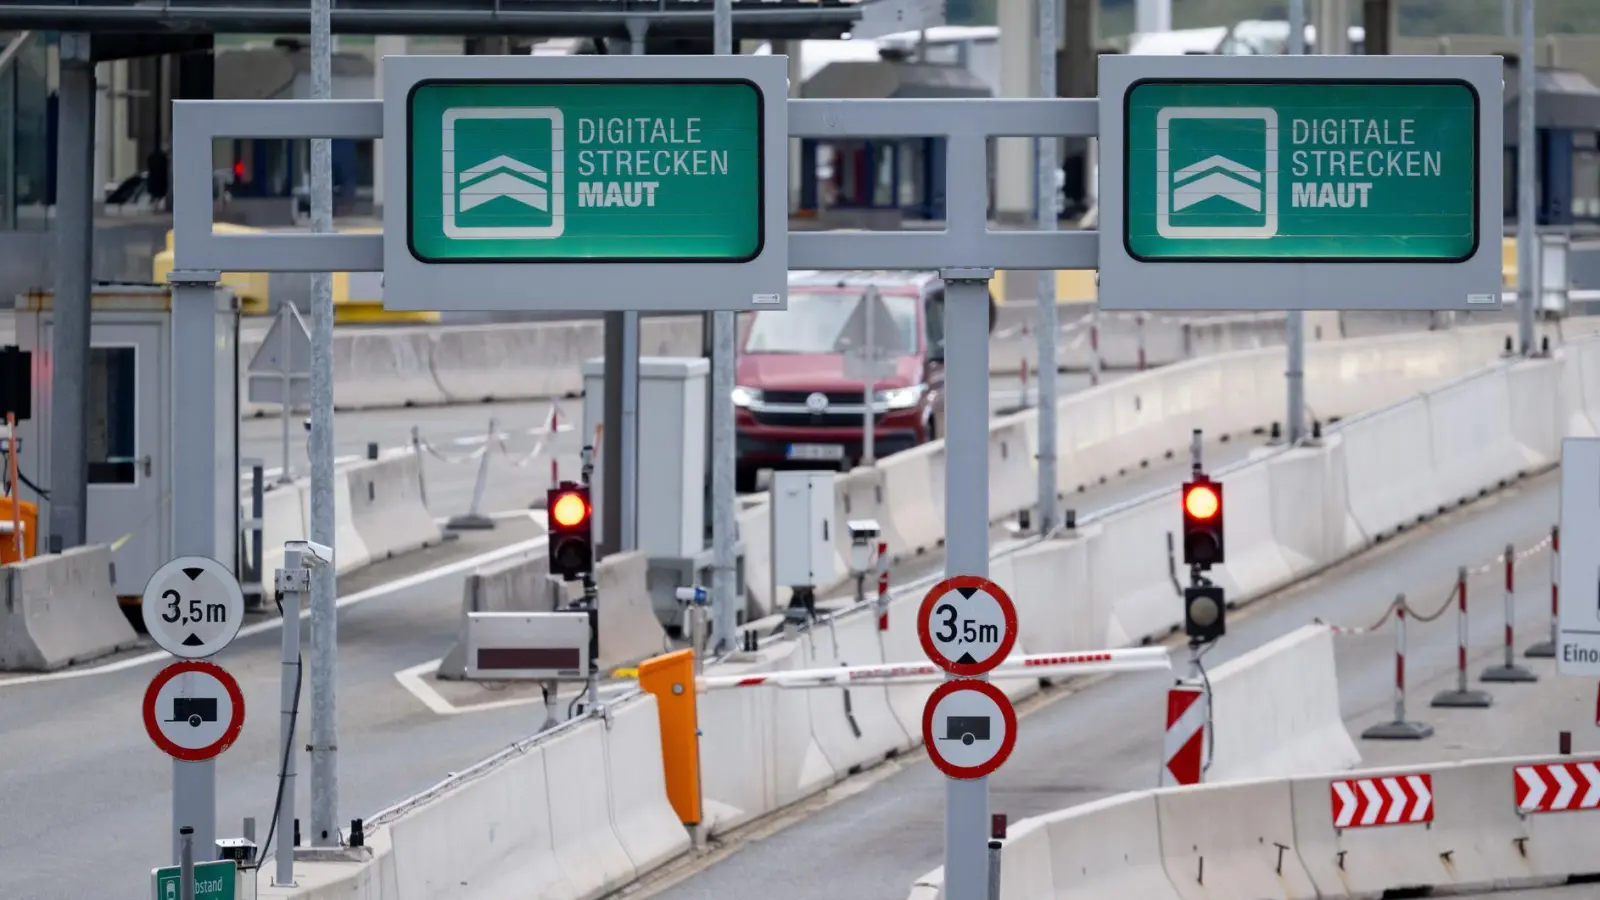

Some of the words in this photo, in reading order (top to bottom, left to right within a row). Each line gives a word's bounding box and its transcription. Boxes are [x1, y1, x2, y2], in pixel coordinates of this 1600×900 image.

[578, 118, 702, 144] DIGITALE
[1292, 119, 1415, 145] DIGITALE
[578, 150, 728, 176] STRECKEN
[1292, 151, 1441, 177] STRECKEN
[578, 181, 659, 207] MAUT
[1291, 182, 1373, 208] MAUT
[935, 604, 998, 645] 3,5m
[1564, 643, 1600, 663] Eino
[194, 876, 223, 895] bstand
